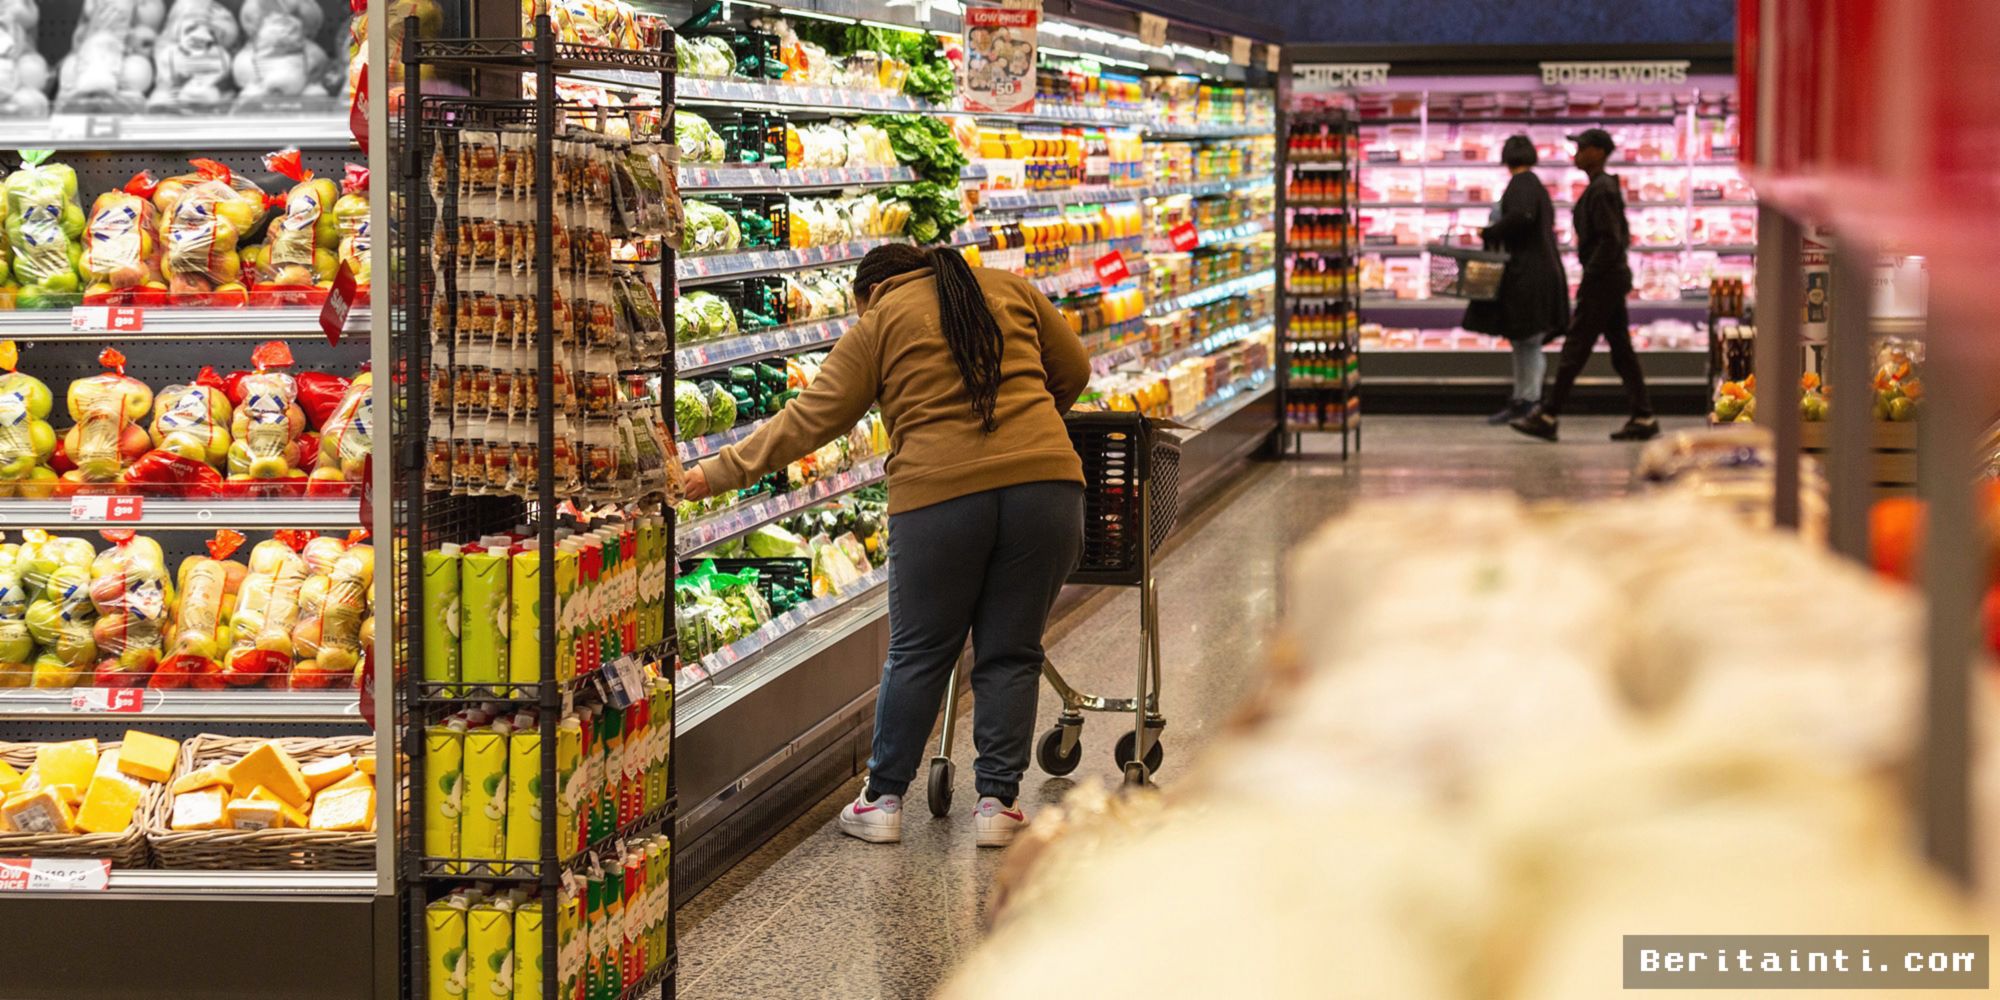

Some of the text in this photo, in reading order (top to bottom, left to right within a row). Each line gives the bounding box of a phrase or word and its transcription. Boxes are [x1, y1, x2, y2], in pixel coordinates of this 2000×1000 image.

[974, 13, 1028, 24] LOW PRICE
[1292, 67, 1389, 87] CHICKEN
[1541, 65, 1688, 85] BOEREWORS
[330, 287, 348, 322] SAVE
[0, 868, 22, 880] OW
